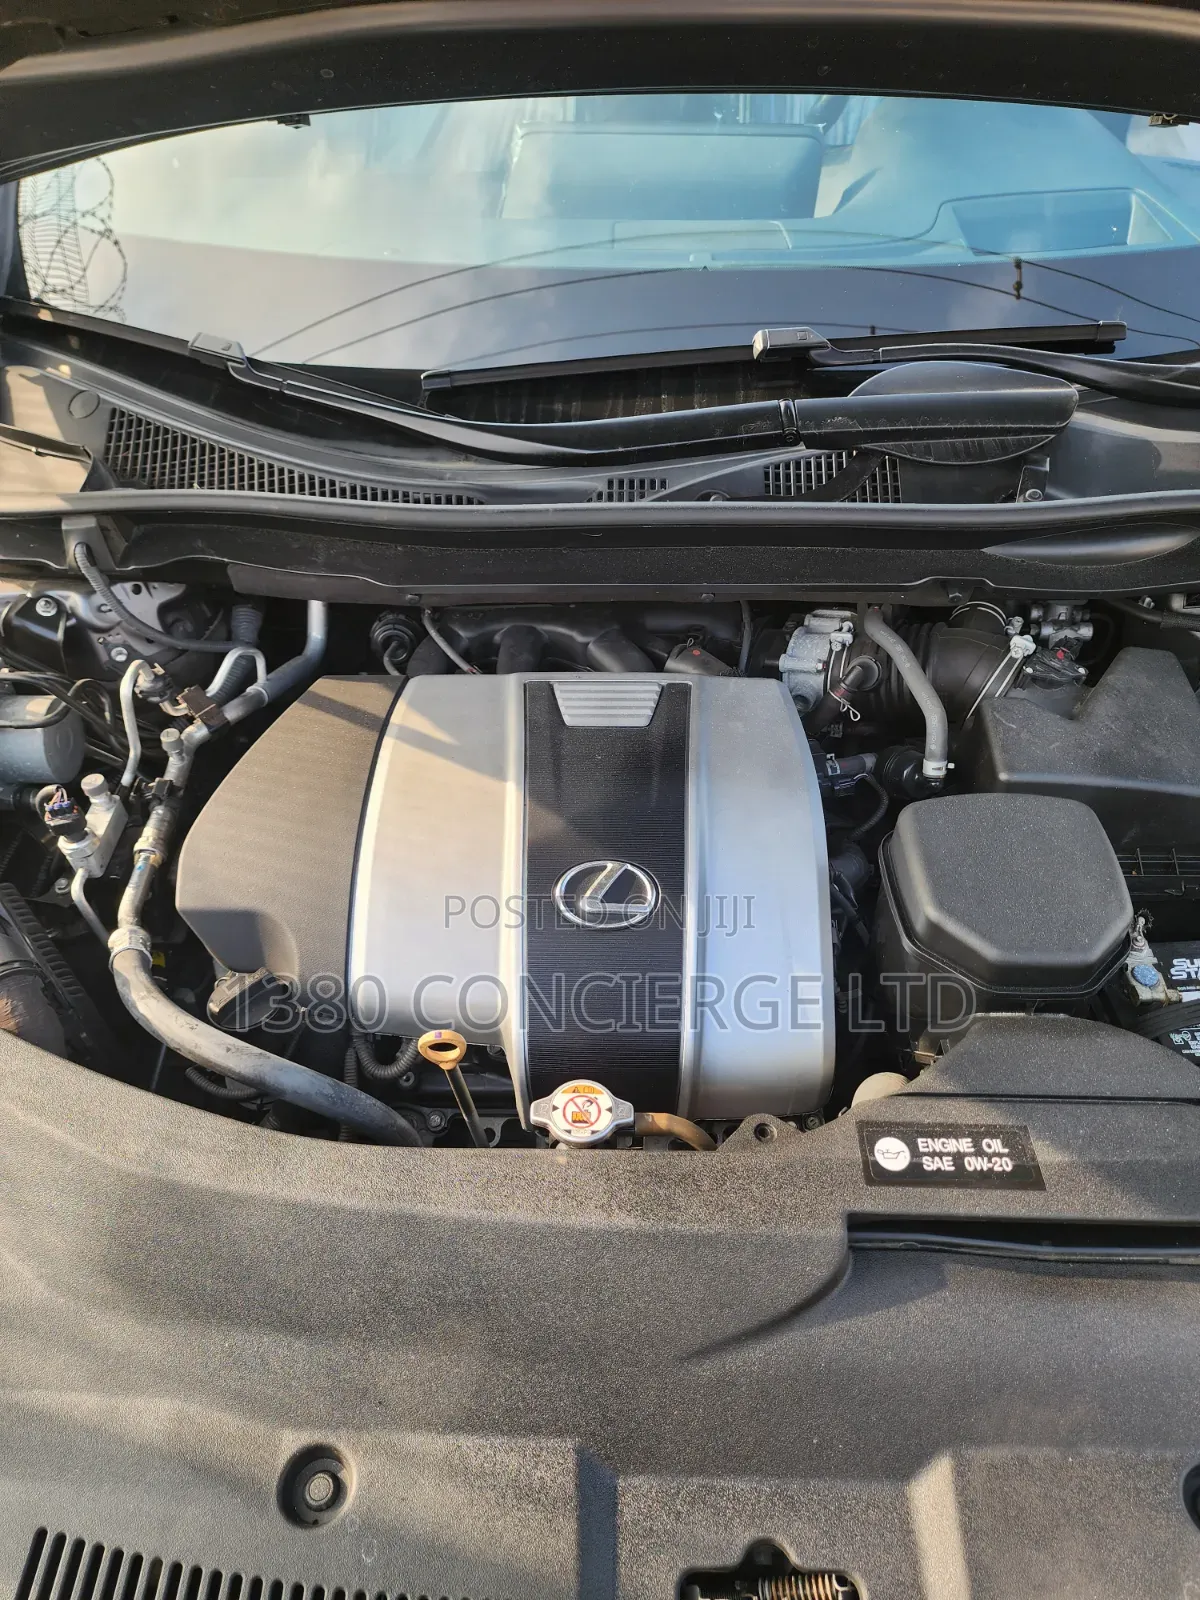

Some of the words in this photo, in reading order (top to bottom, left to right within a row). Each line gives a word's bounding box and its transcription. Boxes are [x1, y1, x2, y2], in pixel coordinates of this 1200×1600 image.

[1172, 958, 1200, 969] SU
[1170, 968, 1200, 980] ST
[917, 1137, 975, 1153] ENGINE
[982, 1138, 1010, 1154] OIL
[922, 1156, 956, 1171] SAE
[964, 1156, 1013, 1172] 0W-20
